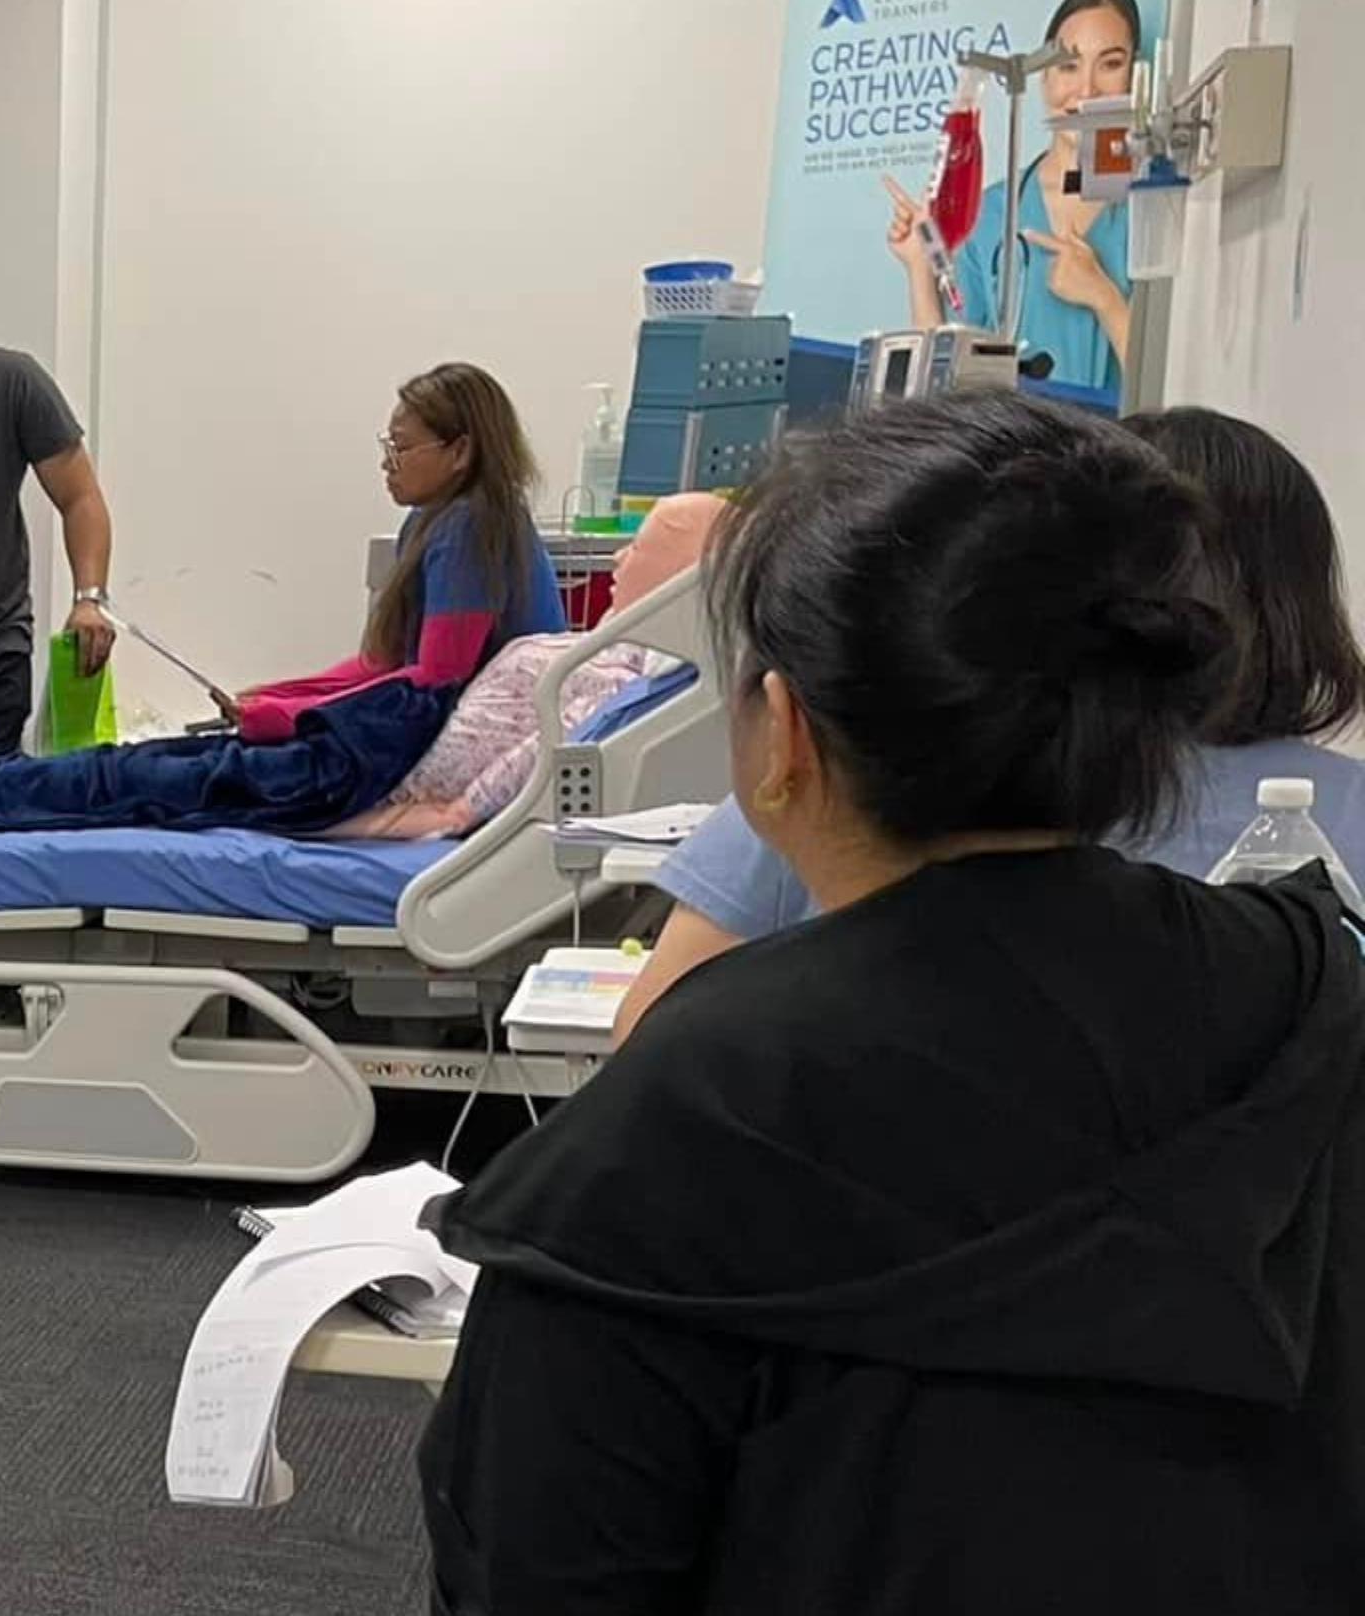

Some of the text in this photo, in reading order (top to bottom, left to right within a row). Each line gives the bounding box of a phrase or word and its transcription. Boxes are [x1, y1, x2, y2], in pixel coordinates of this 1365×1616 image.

[874, 1, 949, 20] TRAINERS
[811, 22, 1011, 75] CREATING A
